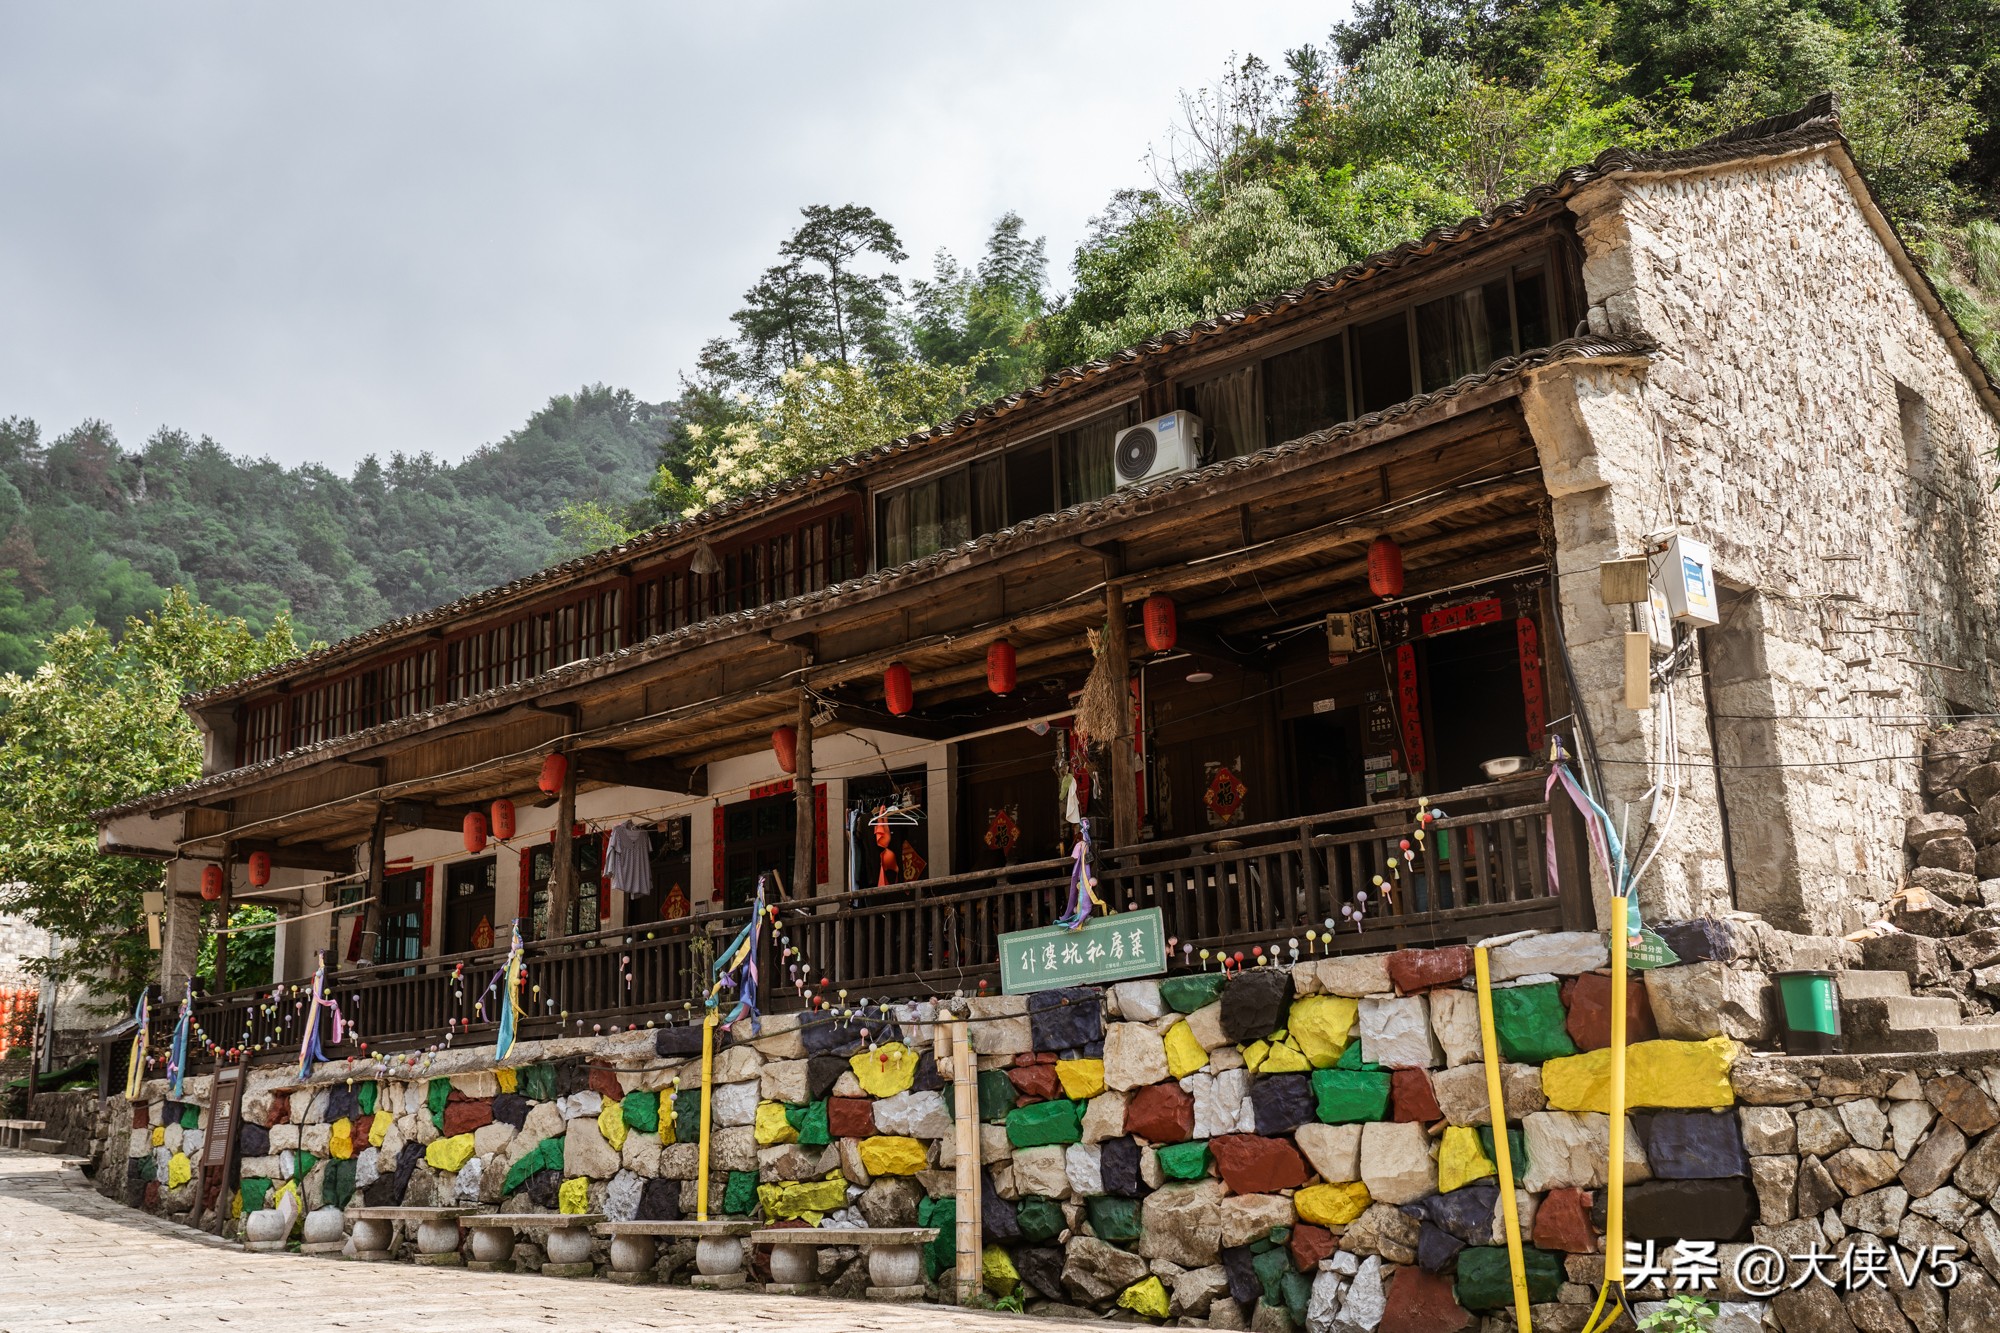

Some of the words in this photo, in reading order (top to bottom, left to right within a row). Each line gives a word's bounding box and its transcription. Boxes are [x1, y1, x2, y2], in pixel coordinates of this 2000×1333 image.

[1158, 602, 1169, 637] 外婆坑
[1216, 781, 1234, 806] 福
[995, 825, 1009, 847] 福
[1021, 928, 1144, 973] 外婆坑私房菜
